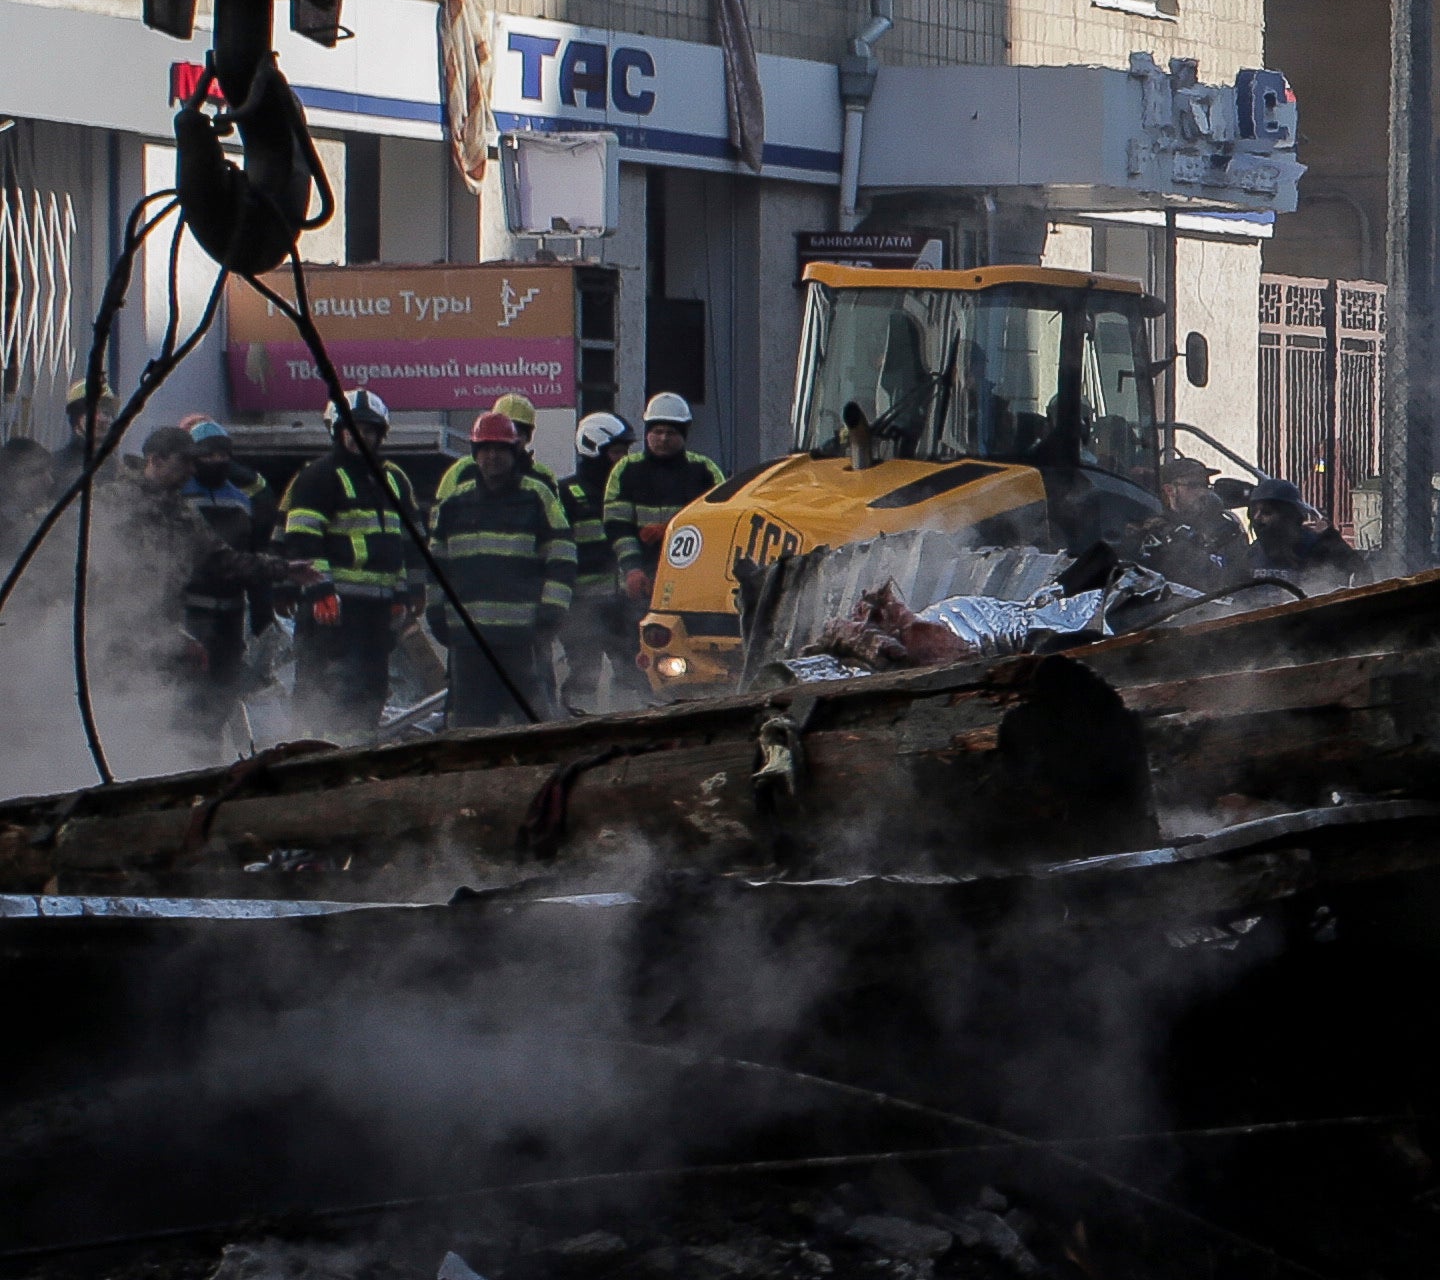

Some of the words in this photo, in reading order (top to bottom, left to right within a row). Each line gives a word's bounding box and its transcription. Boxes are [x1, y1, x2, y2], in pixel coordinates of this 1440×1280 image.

[267, 294, 391, 318] ящие
[399, 290, 472, 322] Туры
[286, 360, 332, 380] Тво
[342, 359, 460, 385] идеальный
[465, 356, 562, 380] маникюр
[671, 536, 695, 557] 20
